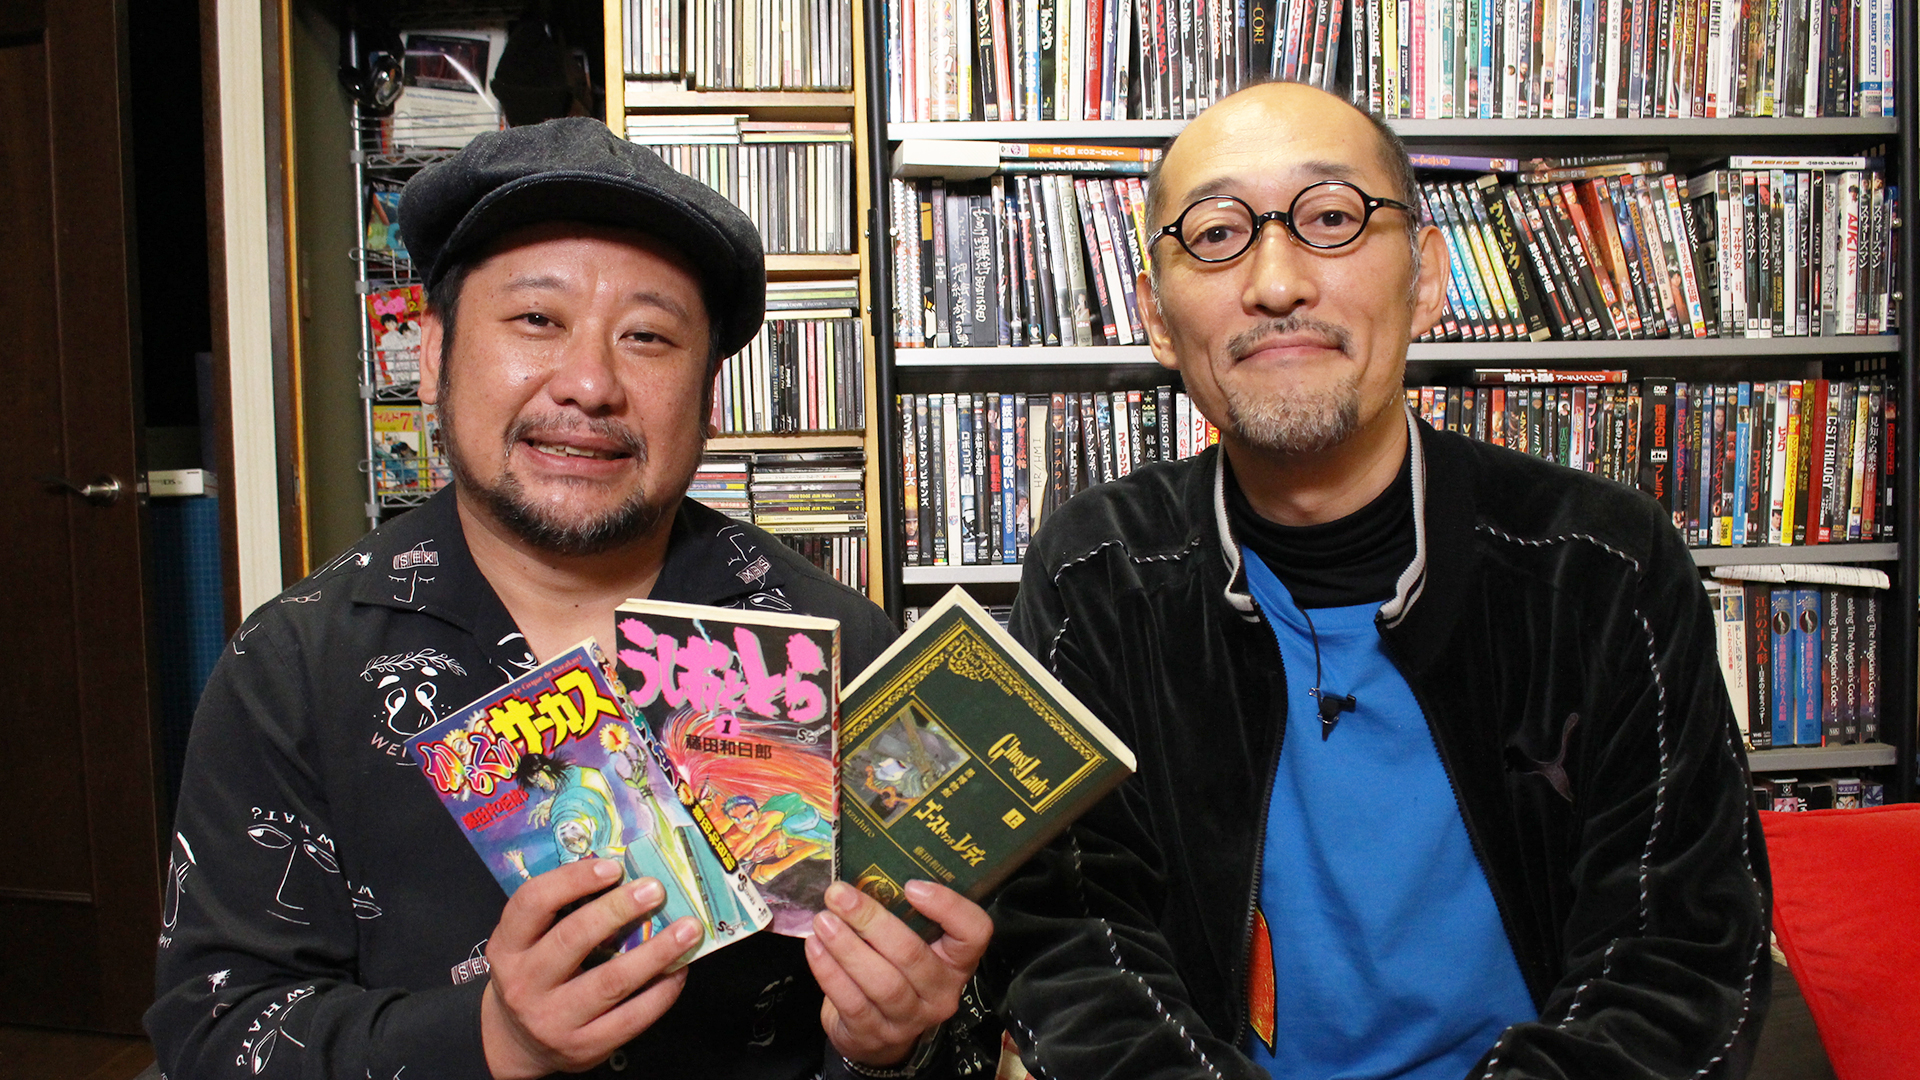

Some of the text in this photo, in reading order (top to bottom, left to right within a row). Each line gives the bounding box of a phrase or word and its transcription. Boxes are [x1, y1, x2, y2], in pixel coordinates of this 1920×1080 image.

[1252, 7, 1266, 45] CORE
[1621, 7, 1633, 46] クロウ
[1488, 199, 1522, 271] ヴィドック
[1682, 202, 1700, 253] エクソシスト
[1732, 227, 1743, 270] マルサの女
[1745, 212, 1756, 261] サスペリア
[1760, 212, 1770, 270] サスペリア2
[1772, 216, 1783, 274] ネイビーシールズ
[1787, 205, 1795, 253] プレデター2
[1846, 212, 1859, 277] AIKI アイキ
[1858, 205, 1870, 269] スウォーズマン
[1871, 205, 1883, 269] スウォーズマン
[1720, 216, 1731, 292] マルサの女をマルサする
[1455, 310, 1466, 320] 10
[1469, 310, 1479, 321] 9
[1484, 310, 1493, 320] 8
[1497, 310, 1507, 320] 6
[1510, 308, 1520, 319] 7
[1653, 385, 1668, 394] DVD
[1161, 413, 1170, 449] KISS OF
[1588, 403, 1598, 454] ブレード
[1654, 403, 1667, 448] 復活の日
[1776, 426, 1788, 453] ビッグ
[1866, 416, 1880, 473] 見知らぬ乗客
[902, 413, 917, 487] ウインドトーカーズ
[918, 425, 930, 507] バットマン ビギンズ
[946, 440, 958, 490] デストラップ
[961, 431, 974, 474] ロボコップ
[1053, 438, 1063, 491] コラテラル
[1083, 417, 1097, 479] アイデンティティー
[1822, 416, 1838, 489] CSI TRILOGY
[742, 557, 769, 583] SEX
[1754, 595, 1769, 665] 江戸の古人形
[1829, 626, 1839, 641] The
[1847, 625, 1855, 640] The
[1867, 623, 1876, 638] The
[552, 655, 584, 674] Karakuri
[616, 617, 827, 724] うしおととら
[1828, 642, 1839, 684] Magician's
[1845, 641, 1855, 683] Magician's
[1865, 639, 1876, 681] Magician's
[486, 668, 622, 756] サーカス
[1830, 684, 1839, 706] Code
[1847, 683, 1856, 705] Code
[1867, 681, 1876, 703] Code
[686, 733, 773, 761] 藤田和日郎
[720, 719, 731, 735] 1
[1015, 757, 1051, 799] Lady
[250, 806, 337, 852] WHAT?
[235, 987, 310, 1068] WHAT?
